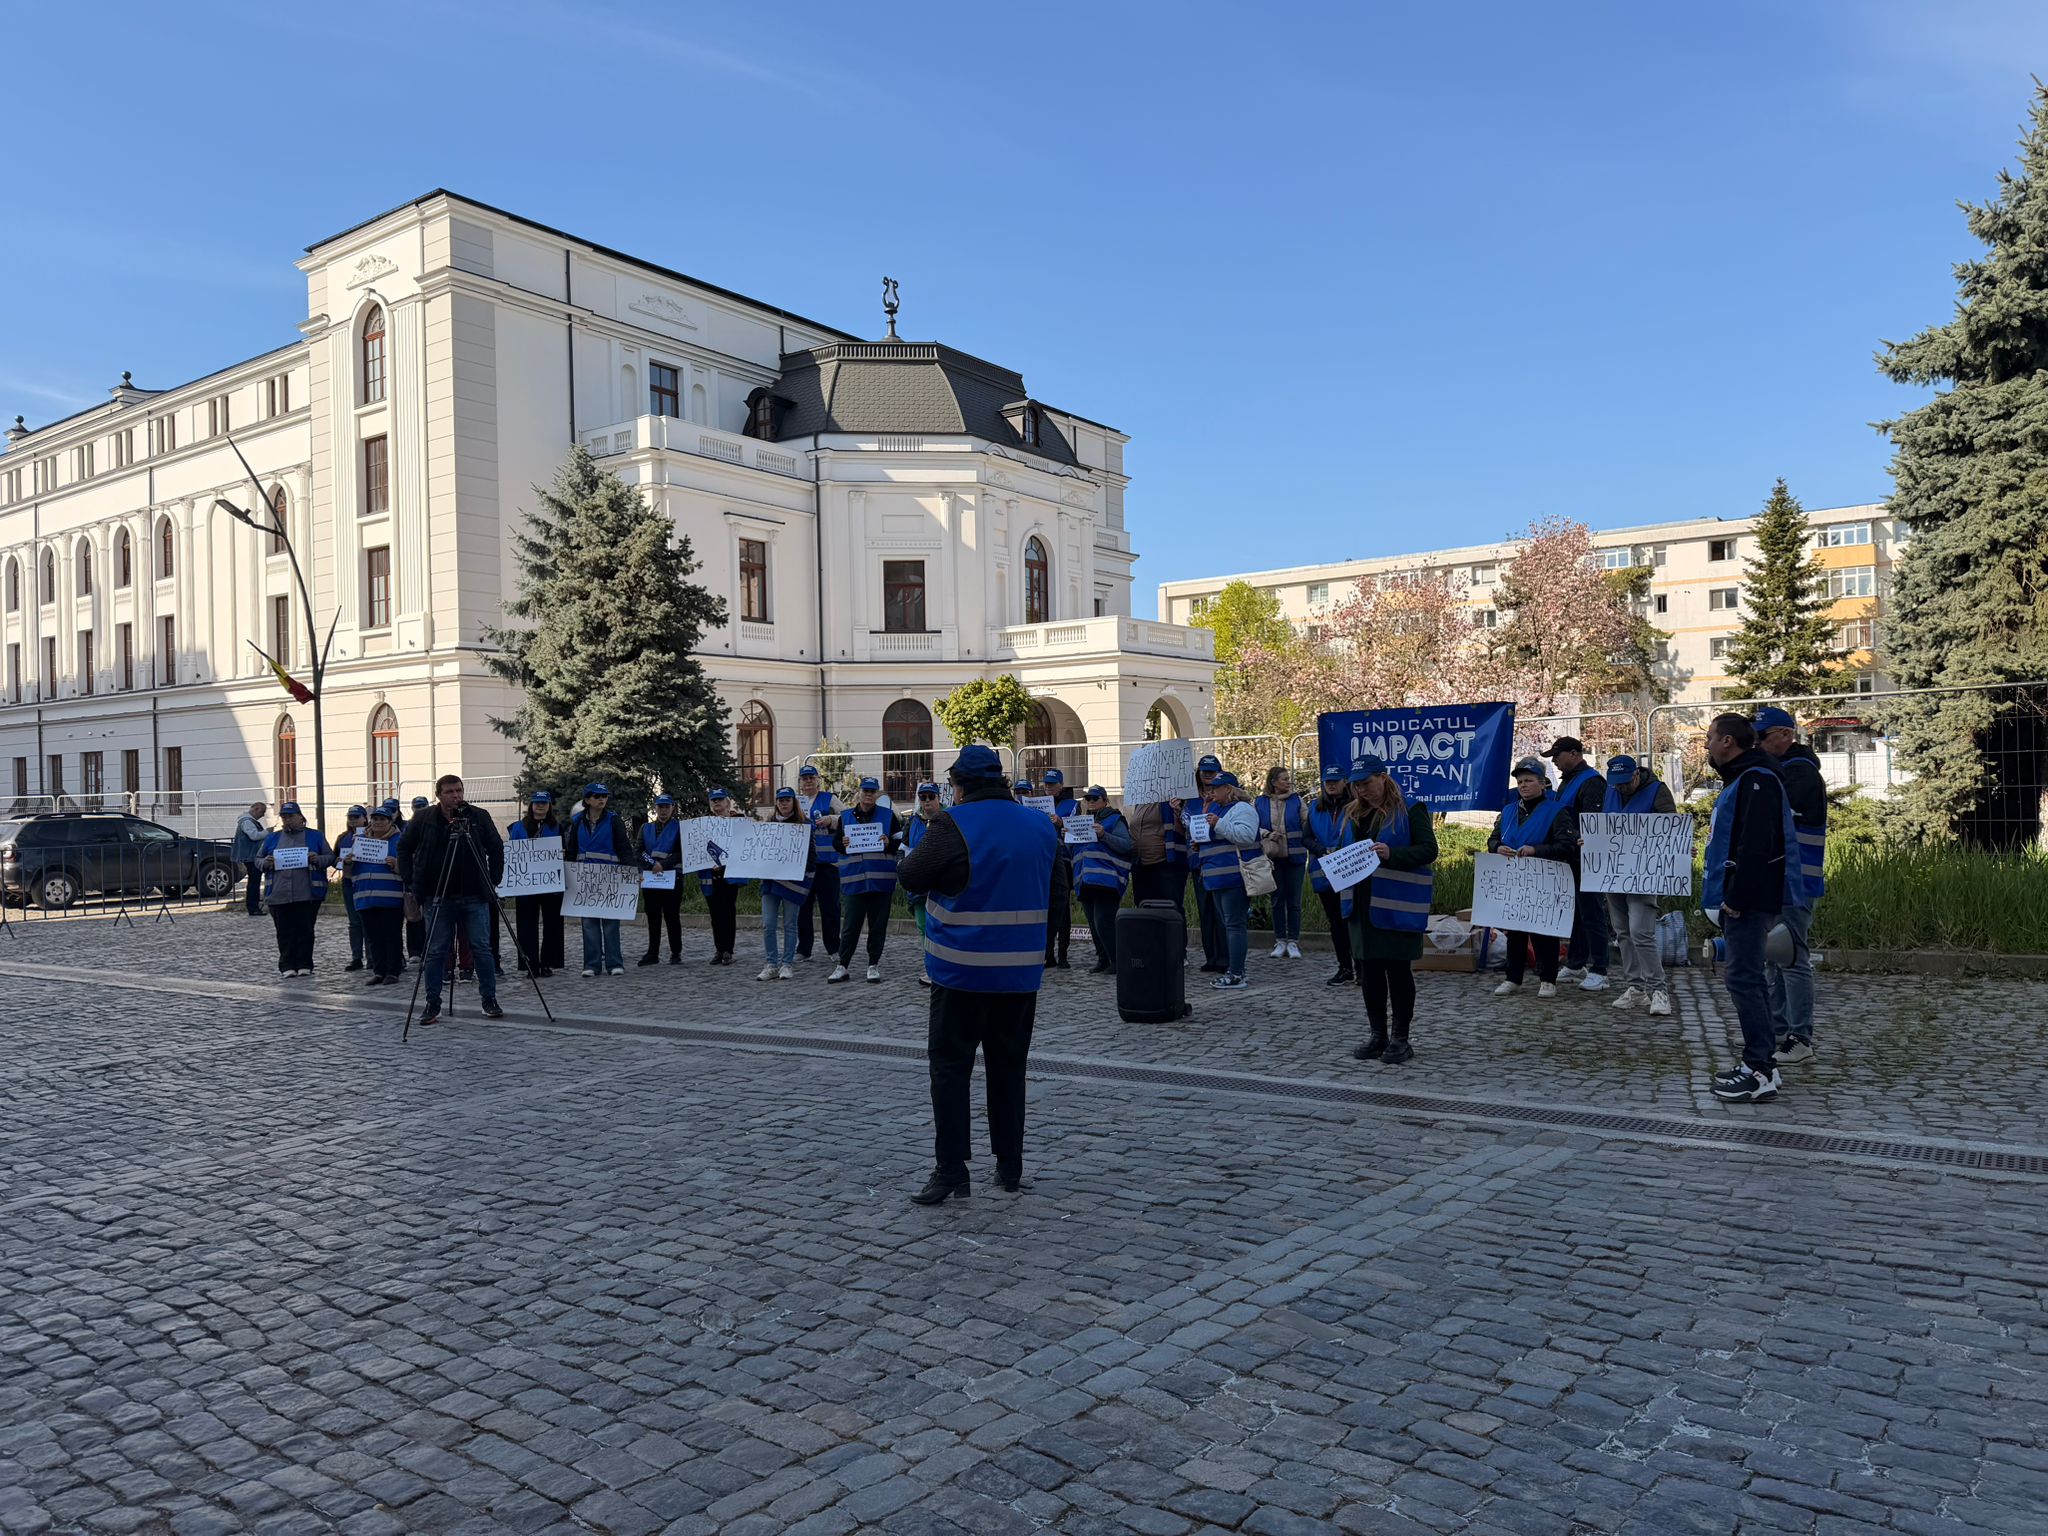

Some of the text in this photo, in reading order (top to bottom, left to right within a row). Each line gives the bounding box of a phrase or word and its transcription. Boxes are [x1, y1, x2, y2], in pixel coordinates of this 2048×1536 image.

[1352, 716, 1476, 734] SINDICATUL
[1350, 731, 1477, 762] IMPACT
[1384, 763, 1472, 787] TOSANI
[1434, 791, 1472, 804] puternici
[752, 823, 805, 838] VREM SA
[1580, 813, 1599, 835] NOI
[1605, 813, 1650, 836] INGRIJIM
[790, 838, 803, 849] NU
[507, 862, 528, 876] NU
[1505, 856, 1566, 877] SUNTEM
[1583, 852, 1676, 876] NU NE JUCAM
[1553, 876, 1570, 894] NU
[1622, 875, 1690, 896] CALCULATOR
